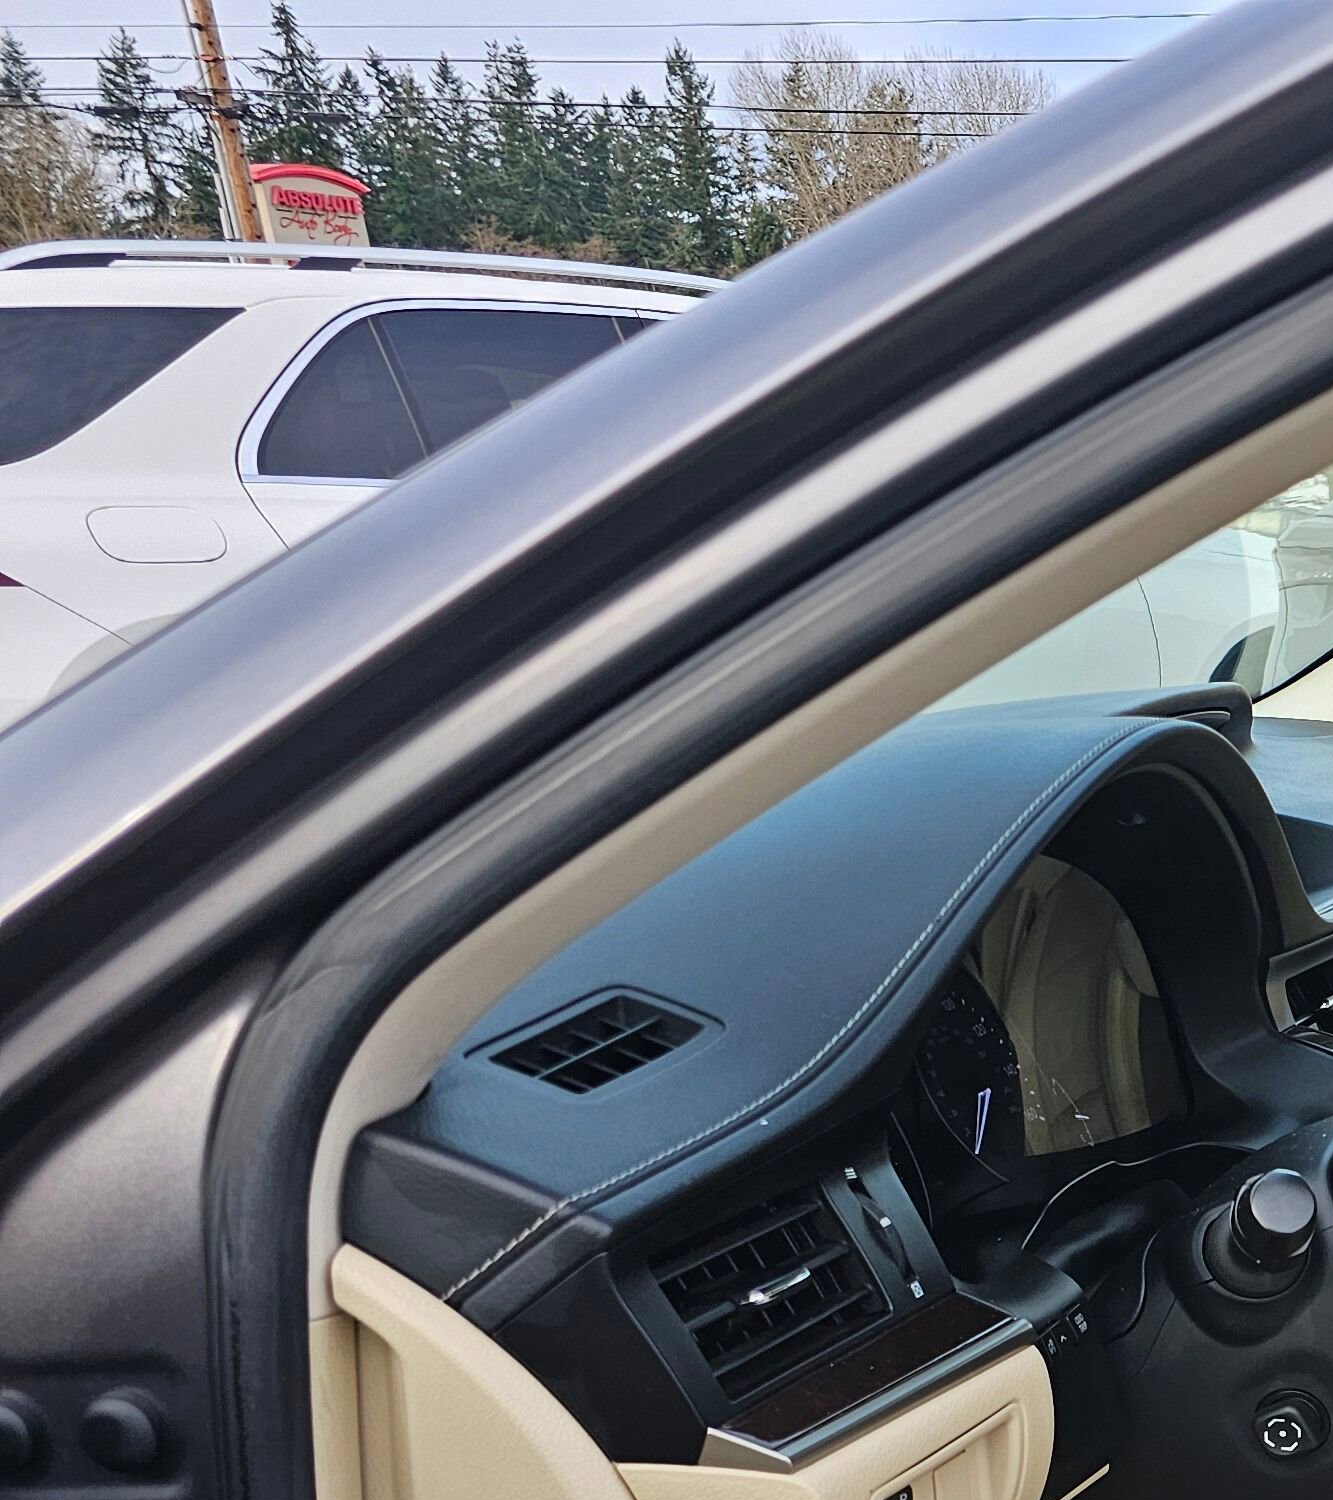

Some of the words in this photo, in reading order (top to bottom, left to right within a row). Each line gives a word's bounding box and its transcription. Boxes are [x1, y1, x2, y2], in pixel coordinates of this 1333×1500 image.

[271, 185, 364, 215] ABSOLUTE
[280, 211, 318, 239] Auto
[323, 210, 359, 246] Body
